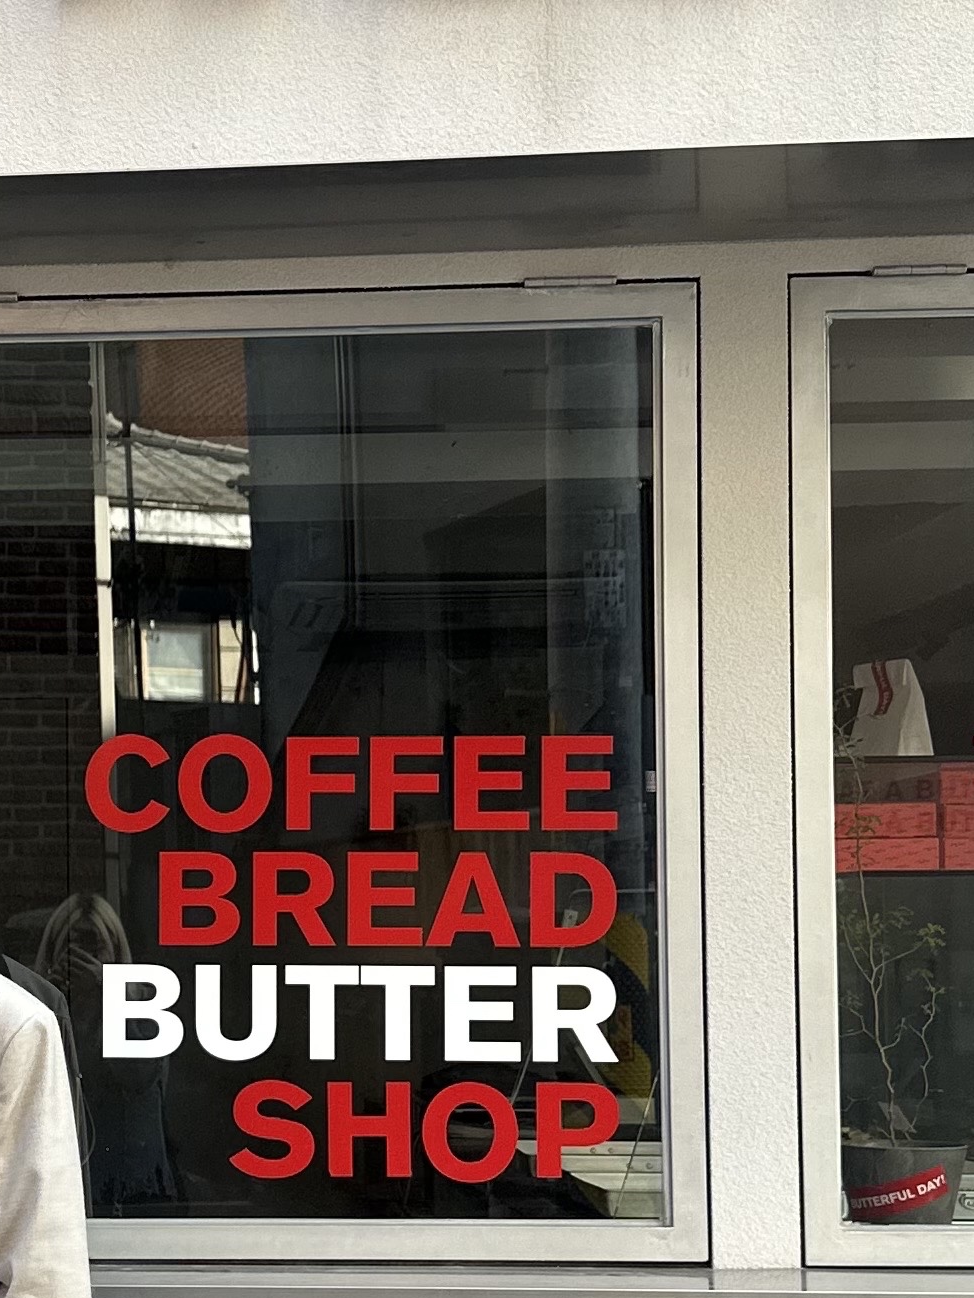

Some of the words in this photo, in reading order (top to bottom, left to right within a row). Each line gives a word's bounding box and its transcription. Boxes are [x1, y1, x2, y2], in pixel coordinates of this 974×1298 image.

[84, 733, 619, 834] COFFEE
[158, 851, 618, 949] BREAD
[102, 963, 620, 1064] BUTTER
[229, 1079, 621, 1184] SHOP
[916, 1174, 946, 1196] DAY!
